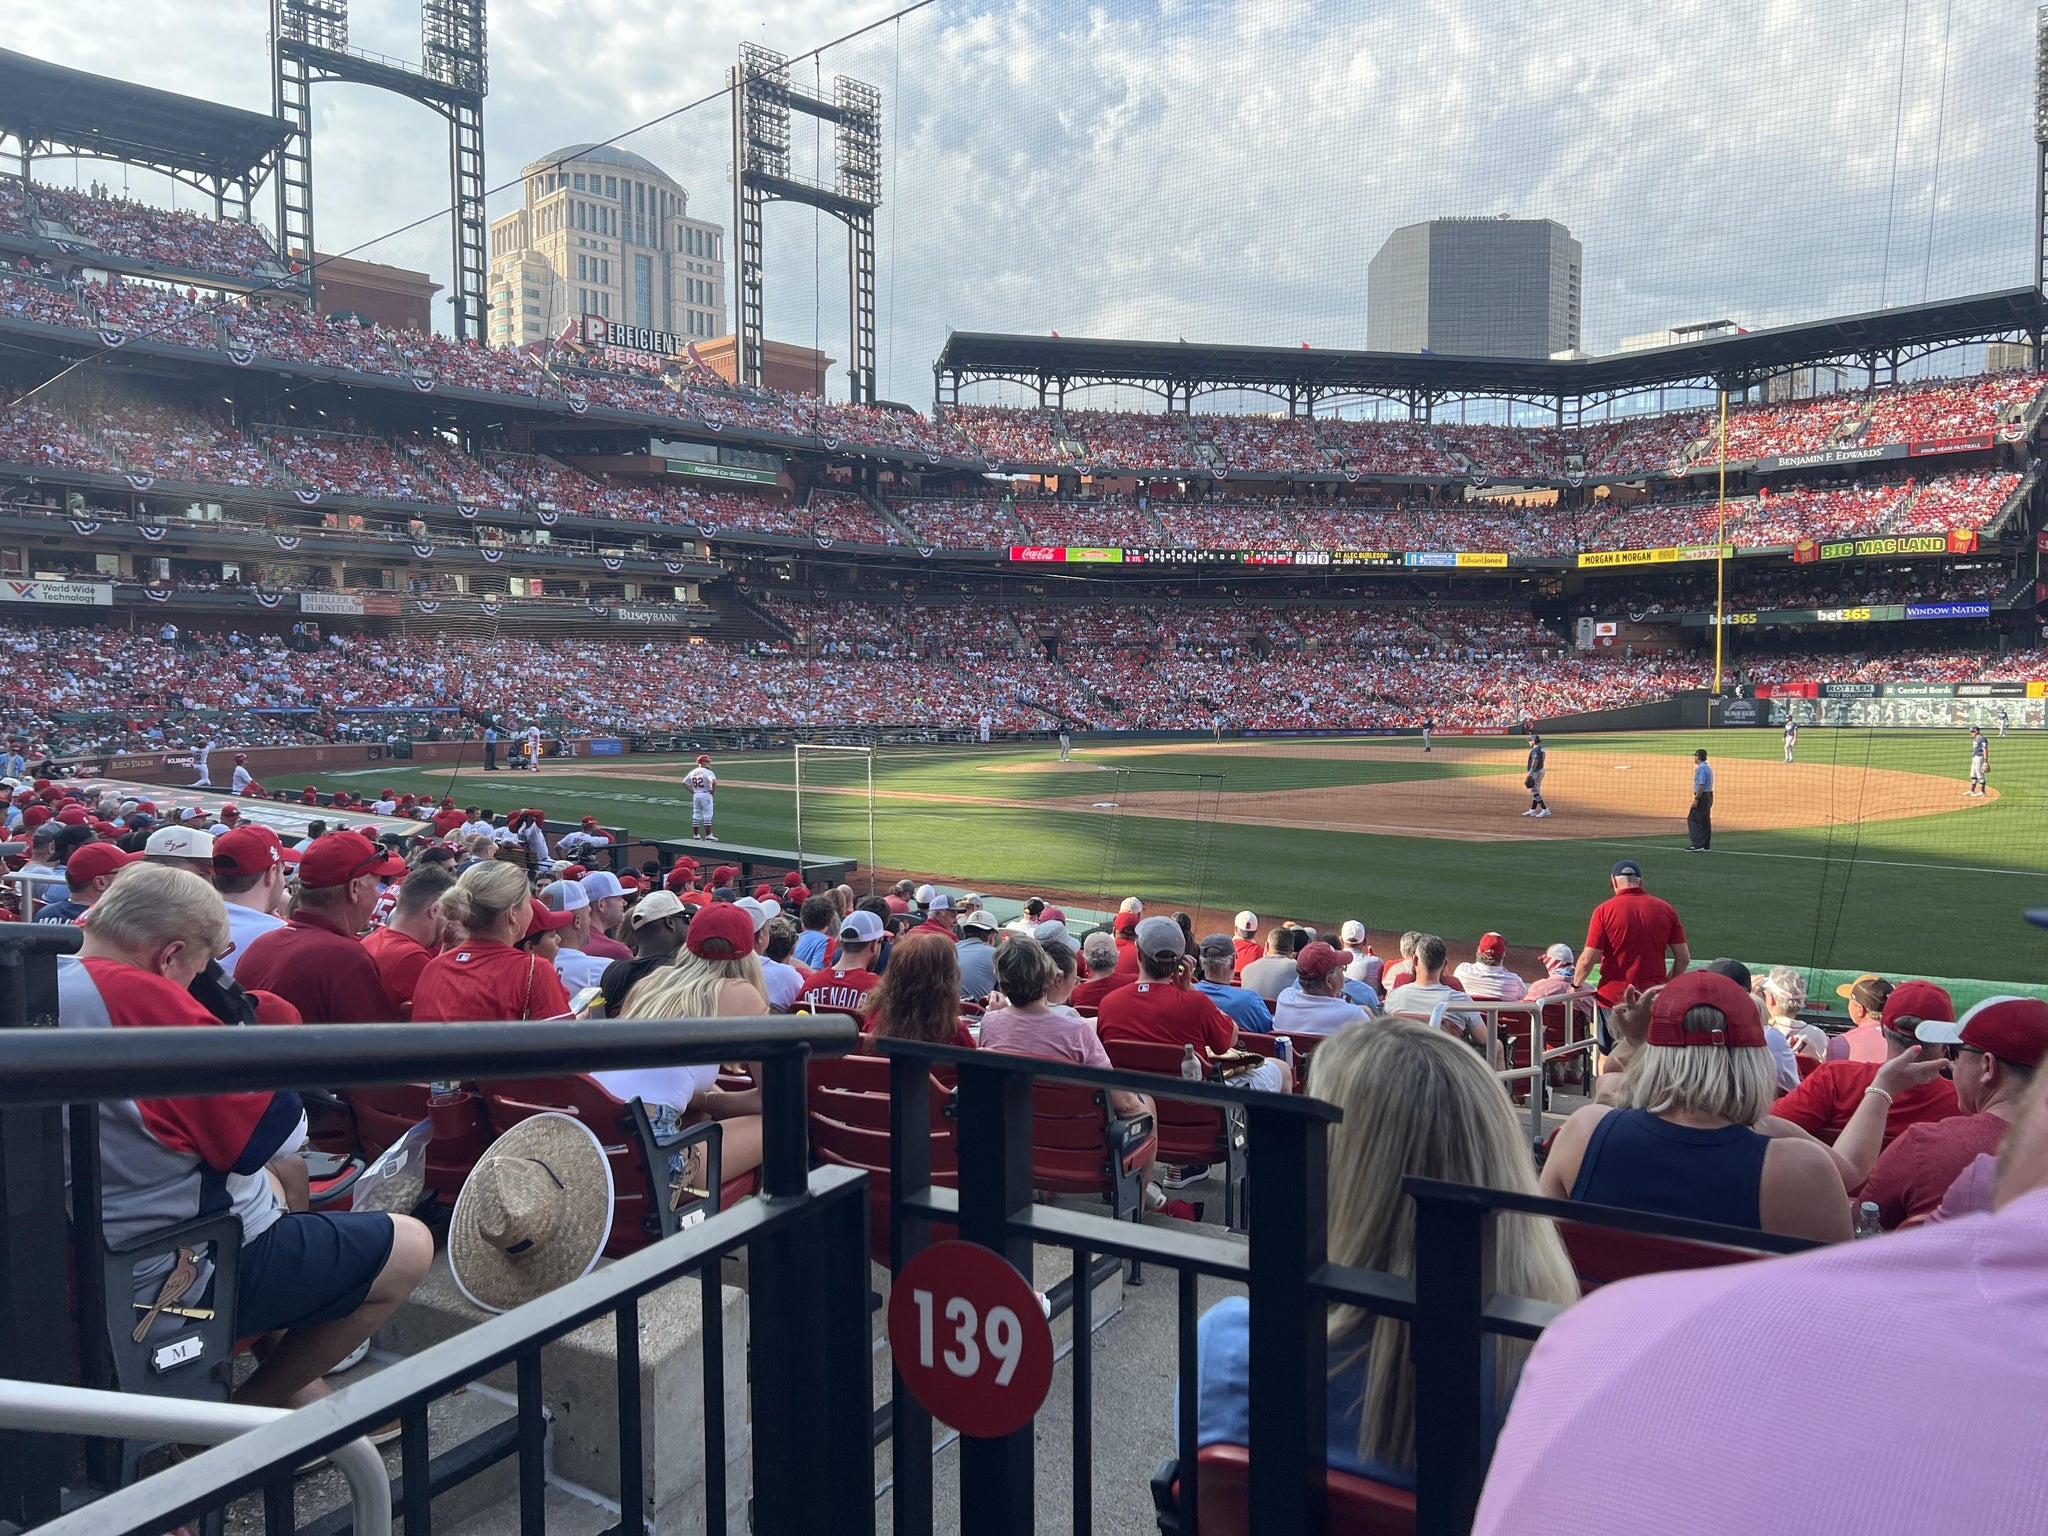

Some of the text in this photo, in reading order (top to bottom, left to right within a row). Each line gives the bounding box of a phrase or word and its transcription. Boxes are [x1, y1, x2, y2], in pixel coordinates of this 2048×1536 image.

[585, 314, 681, 355] PERFICIENT
[604, 348, 661, 369] PERCH
[1779, 454, 1824, 467] BENJAMIN
[1826, 453, 1834, 462] F.
[694, 466, 719, 475] National
[730, 471, 746, 479] Rental
[746, 472, 758, 480] Club
[1820, 537, 1946, 559] BIG MAC LAND
[1484, 556, 1503, 564] Jones
[1585, 554, 1613, 565] MORGAN
[1614, 554, 1621, 562] &
[1622, 552, 1651, 563] MORGAN
[42, 583, 96, 594] World Wide
[42, 592, 96, 604] Technology
[305, 595, 349, 605] MUELLER
[1817, 609, 1871, 621] bet365
[1906, 605, 1989, 616] WINDOW NATION
[1897, 686, 1952, 694] Central Bank
[112, 760, 130, 770] BUSCH
[131, 759, 154, 768] STADIUM
[167, 757, 195, 765] KUMHO
[692, 777, 705, 788] 82
[913, 1288, 1023, 1388] 139
[171, 1344, 187, 1362] M
